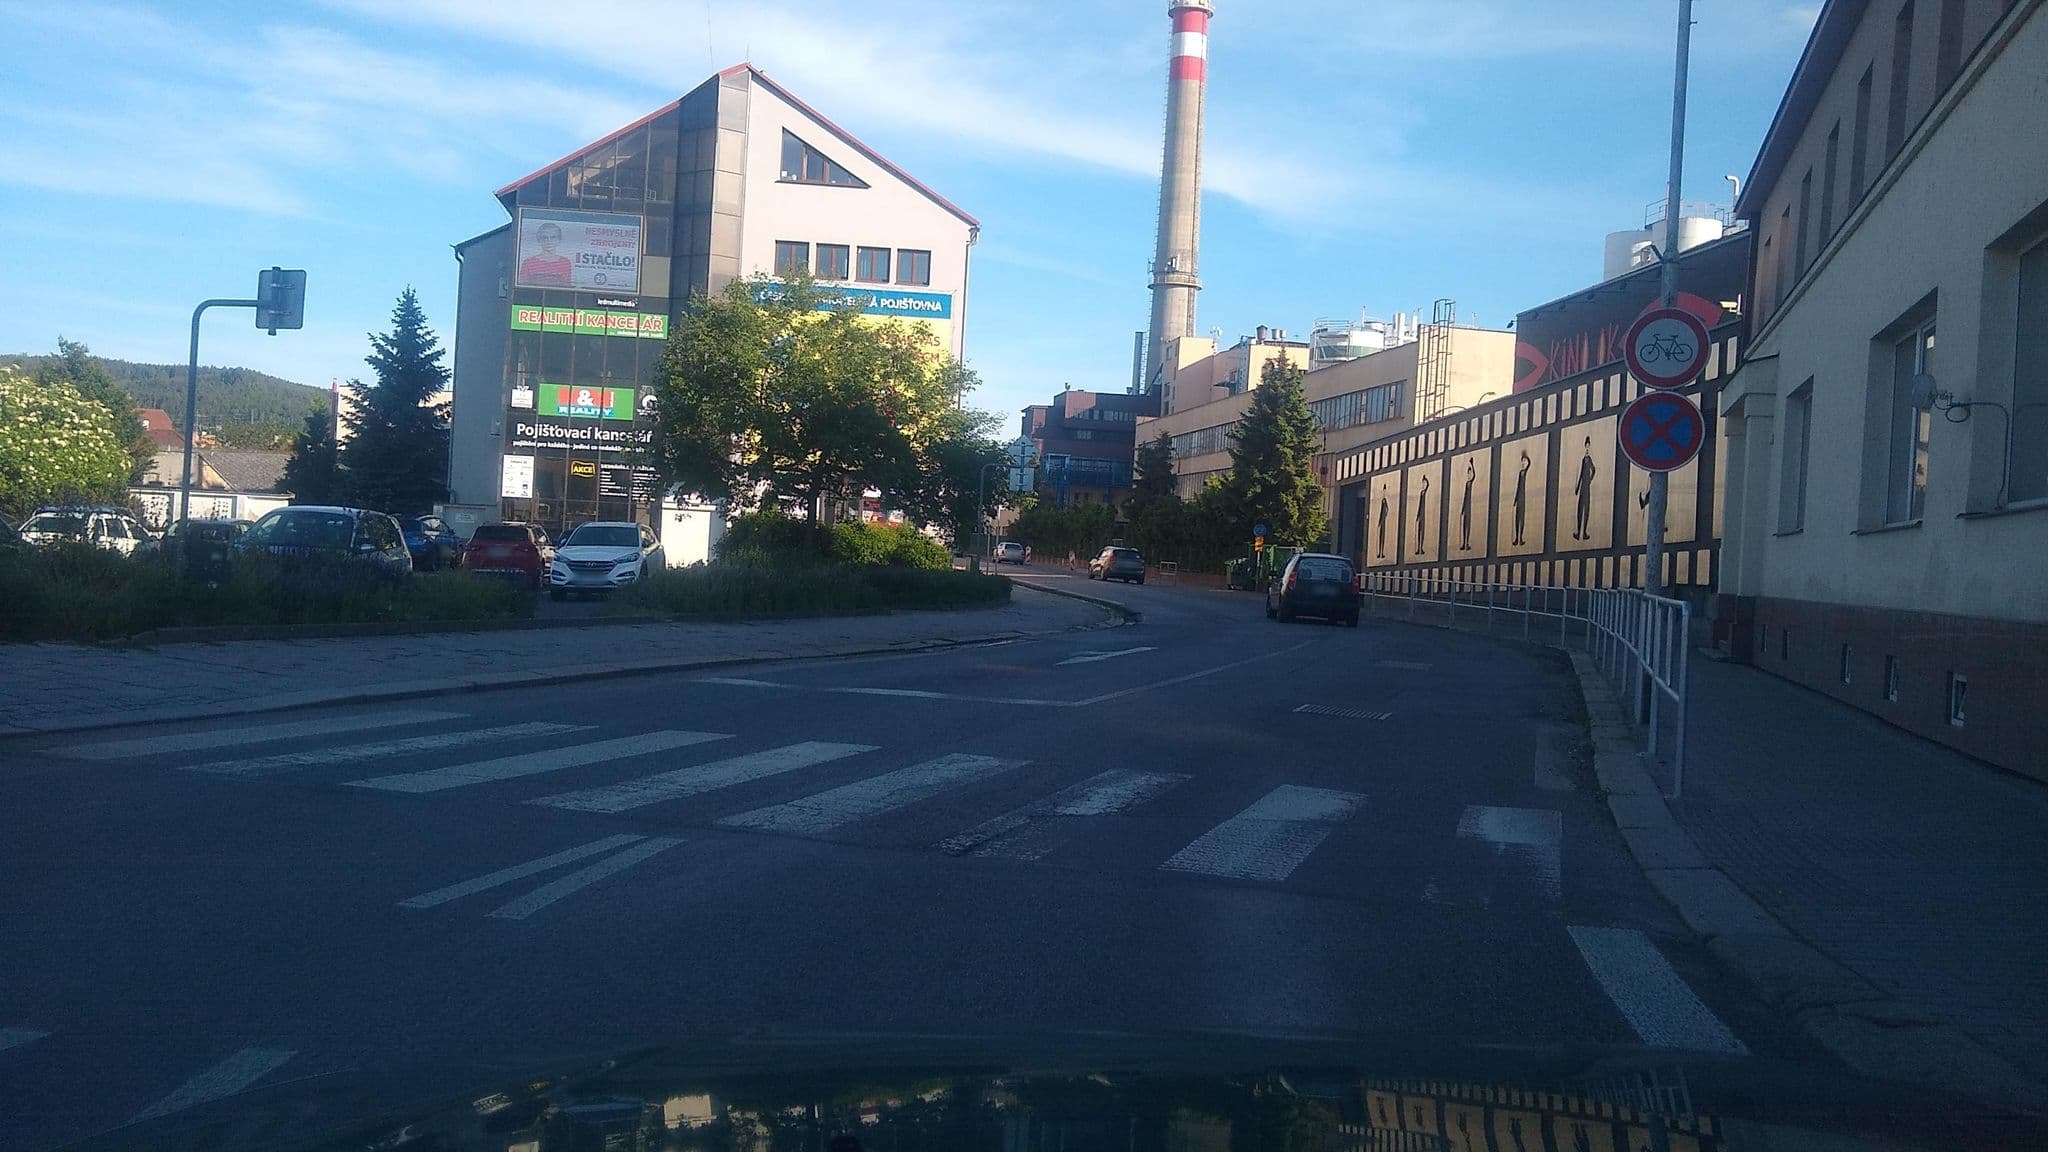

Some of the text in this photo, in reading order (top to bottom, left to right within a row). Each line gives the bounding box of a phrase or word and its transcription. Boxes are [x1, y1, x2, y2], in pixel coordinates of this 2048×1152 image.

[582, 250, 635, 267] STAČILO!
[880, 297, 942, 312] POJIŠŤOVNA
[519, 310, 663, 331] REALITNÍ KANCELÁŘ
[558, 405, 611, 417] REALITY
[516, 422, 591, 439] Pojišťovací
[573, 465, 592, 474] AKCE
